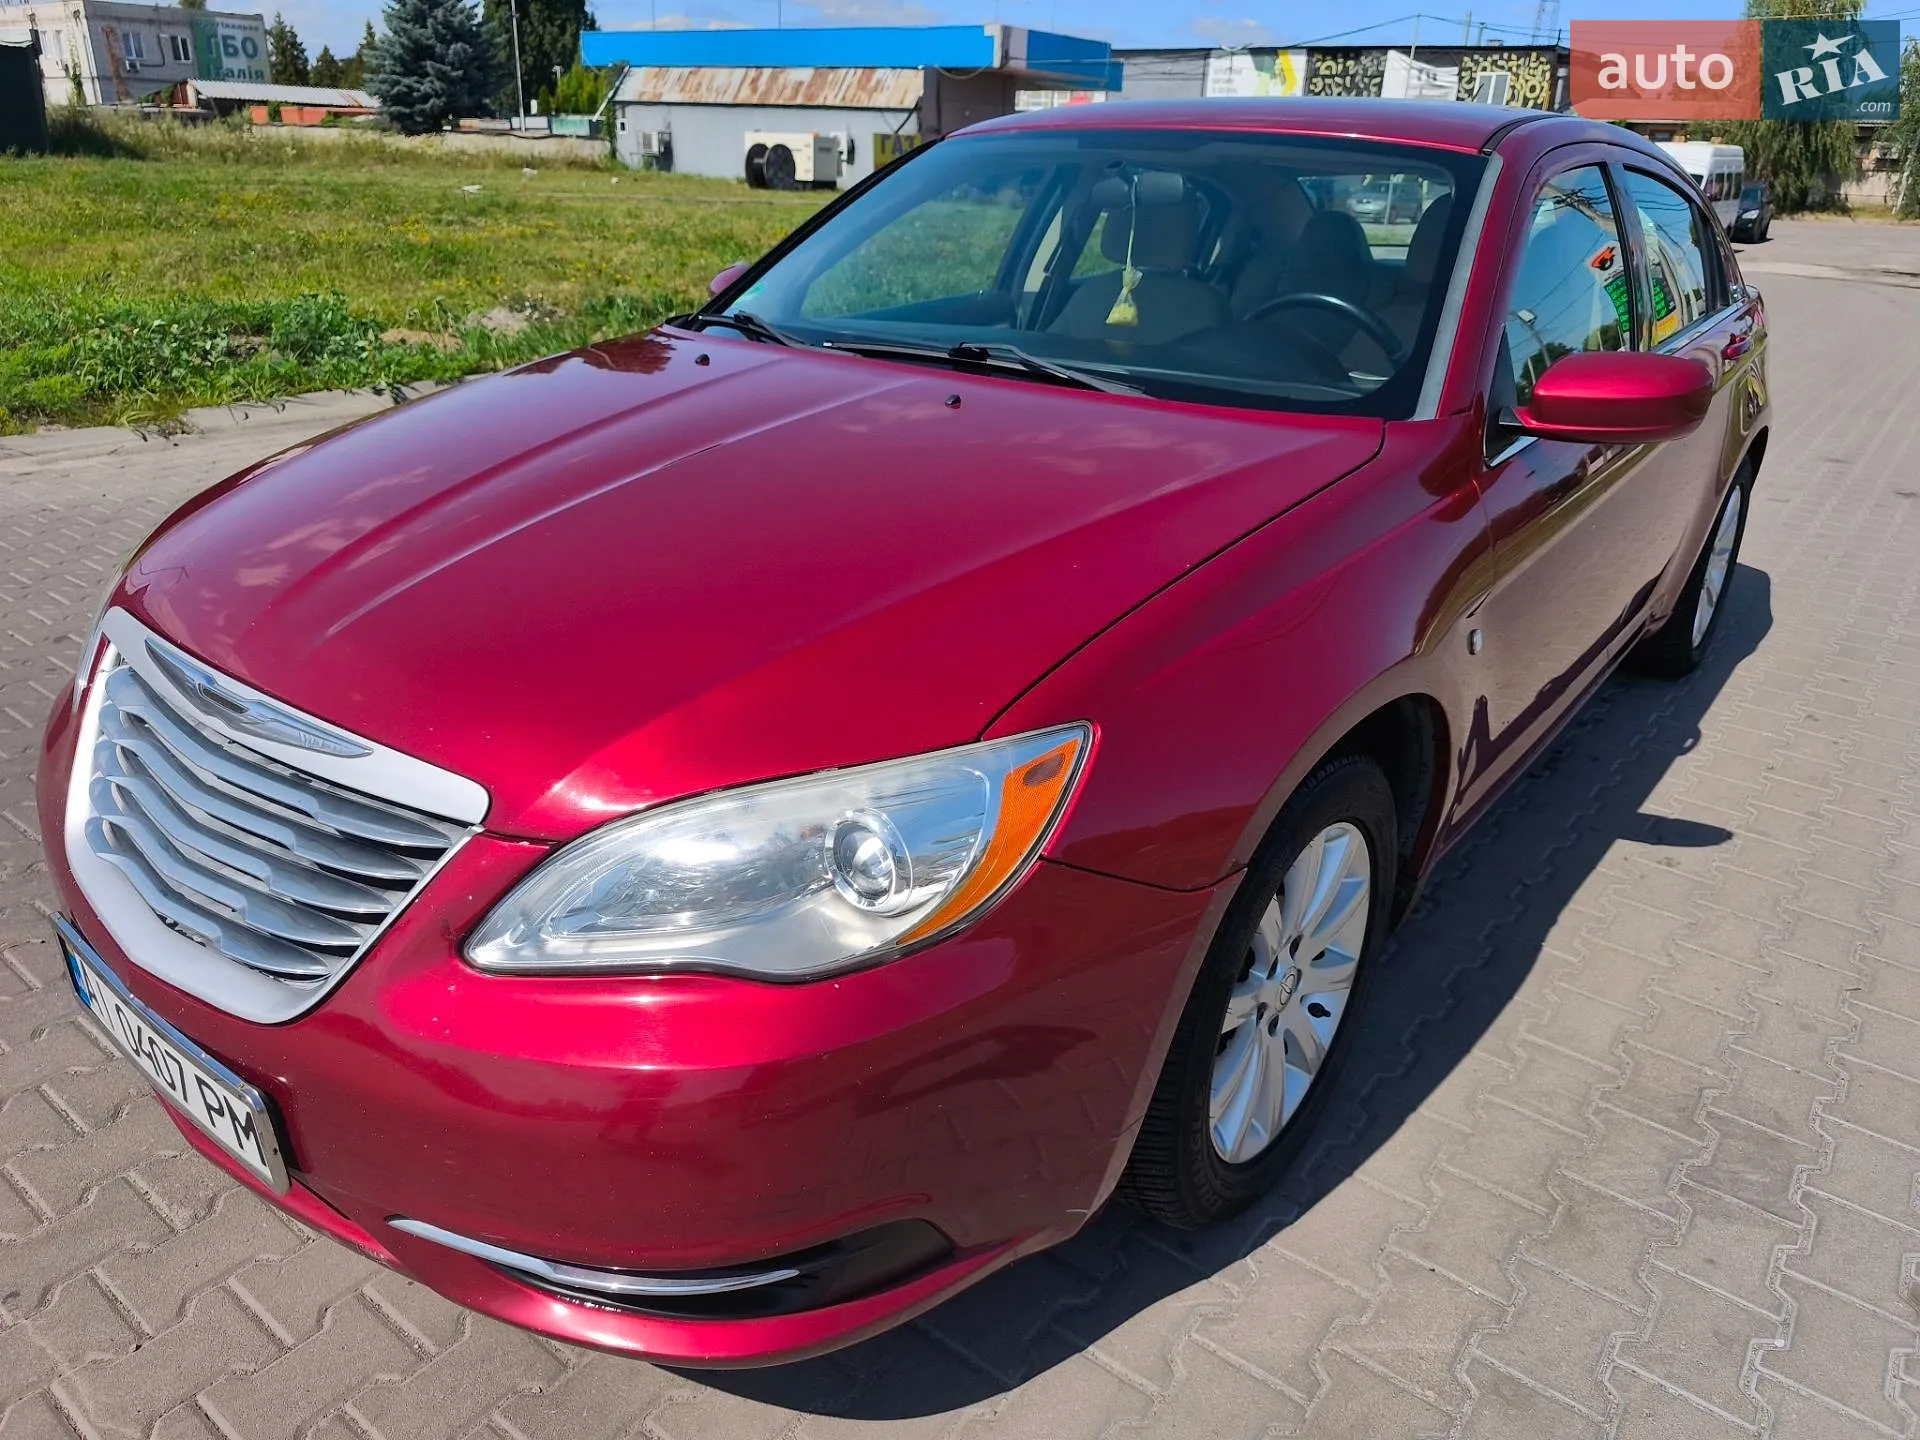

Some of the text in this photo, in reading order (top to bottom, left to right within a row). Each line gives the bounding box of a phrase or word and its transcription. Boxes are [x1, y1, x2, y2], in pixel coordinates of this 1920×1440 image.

[207, 34, 258, 59] ГБО
[79, 958, 267, 1167] AI 0407 PM
